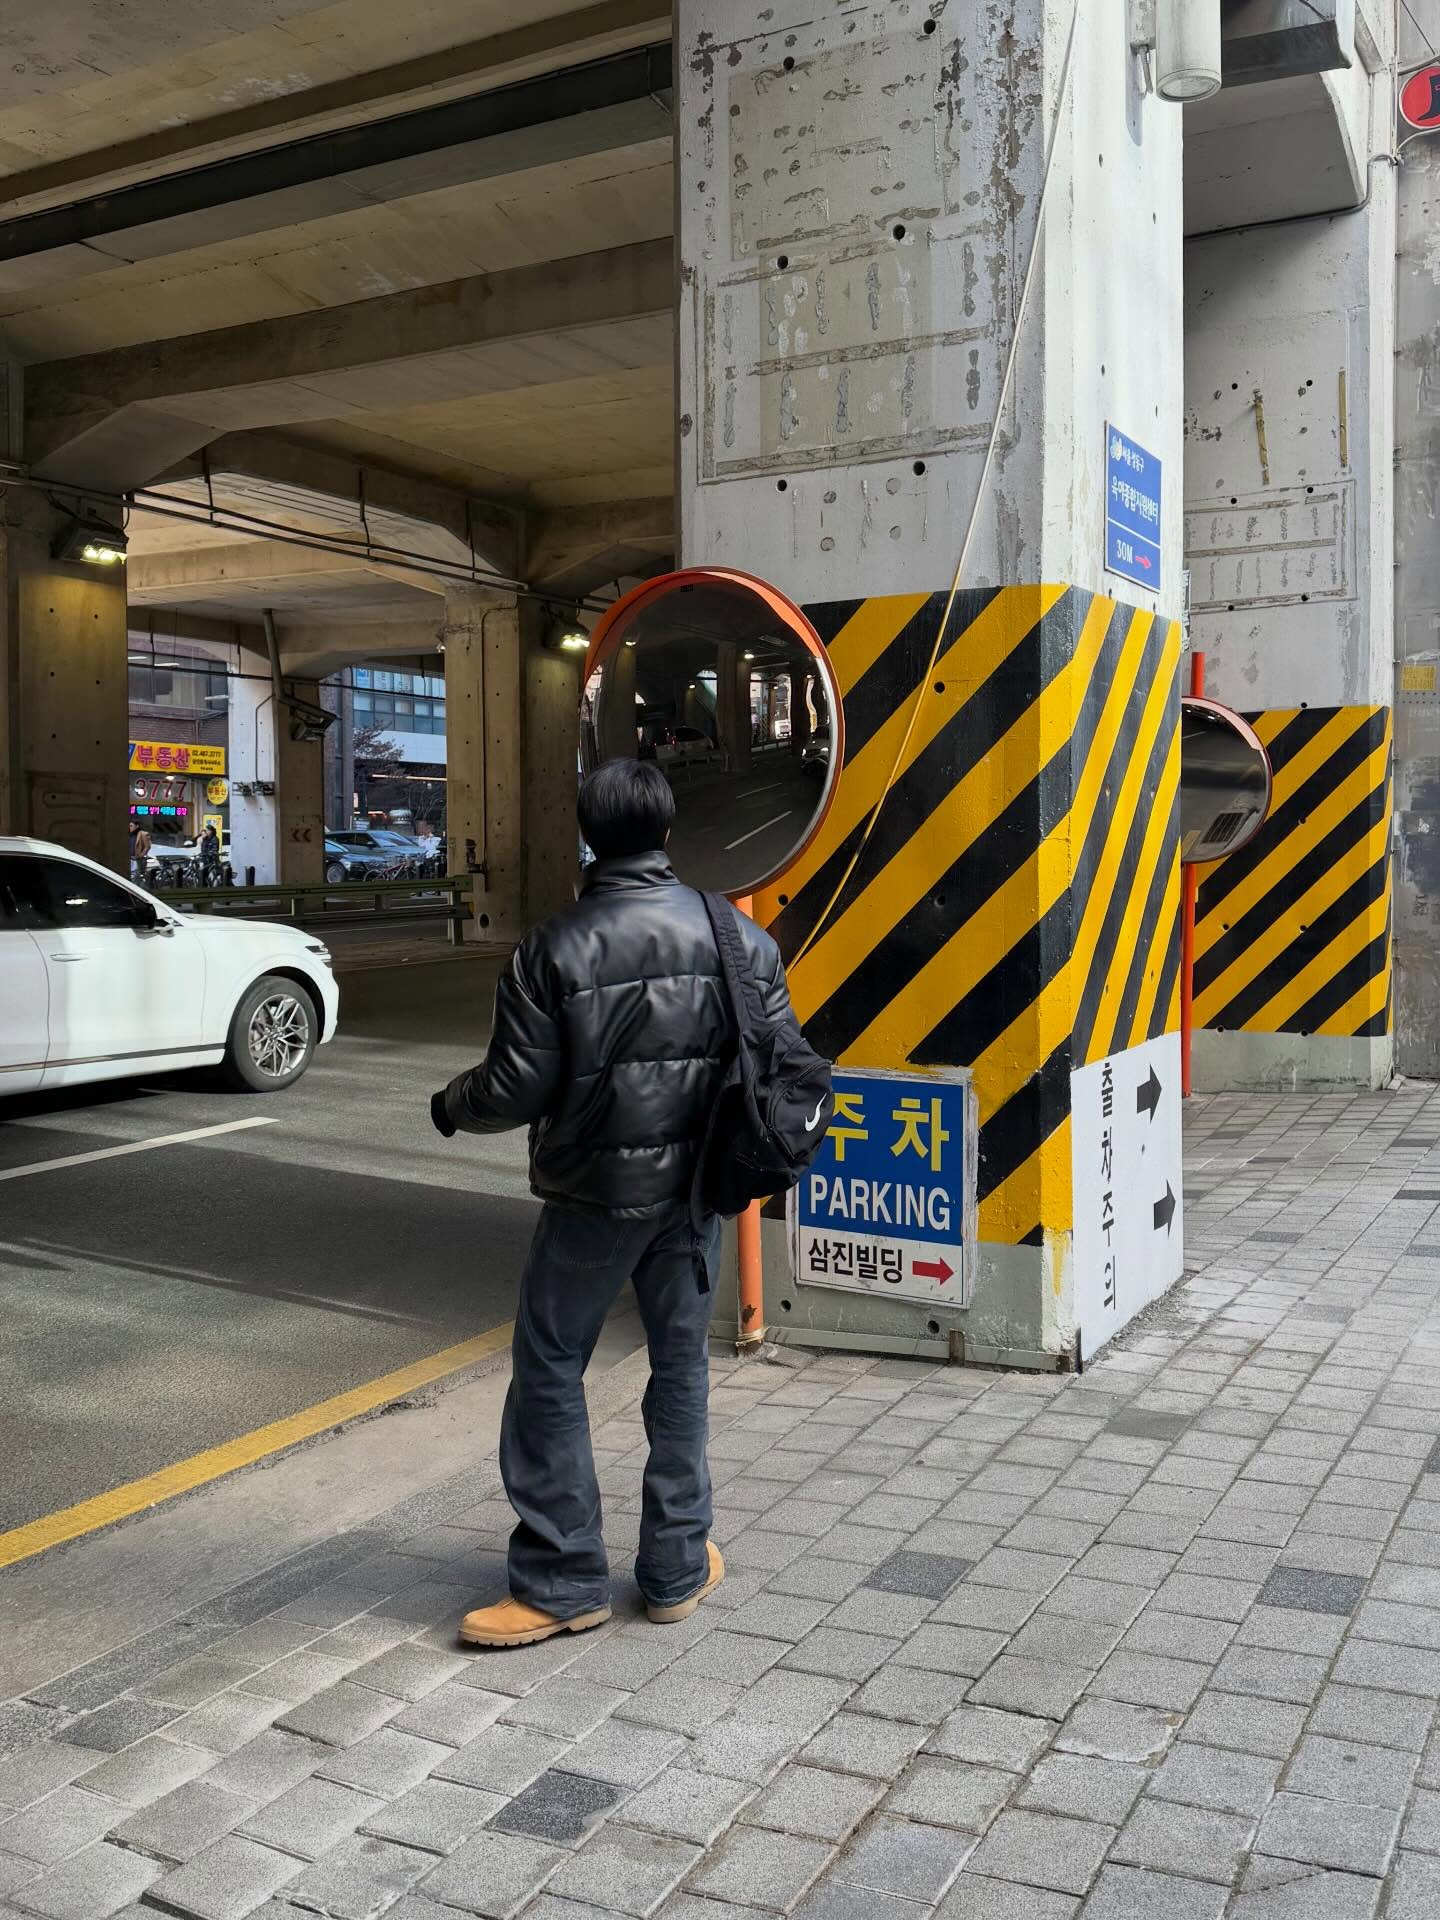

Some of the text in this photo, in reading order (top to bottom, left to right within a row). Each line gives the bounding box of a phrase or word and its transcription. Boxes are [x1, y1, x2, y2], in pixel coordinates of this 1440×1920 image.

[1116, 538, 1133, 564] 30M
[137, 744, 190, 770] 부동산
[810, 1173, 950, 1231] PARKING
[808, 1237, 903, 1284] 삼진빌딩
